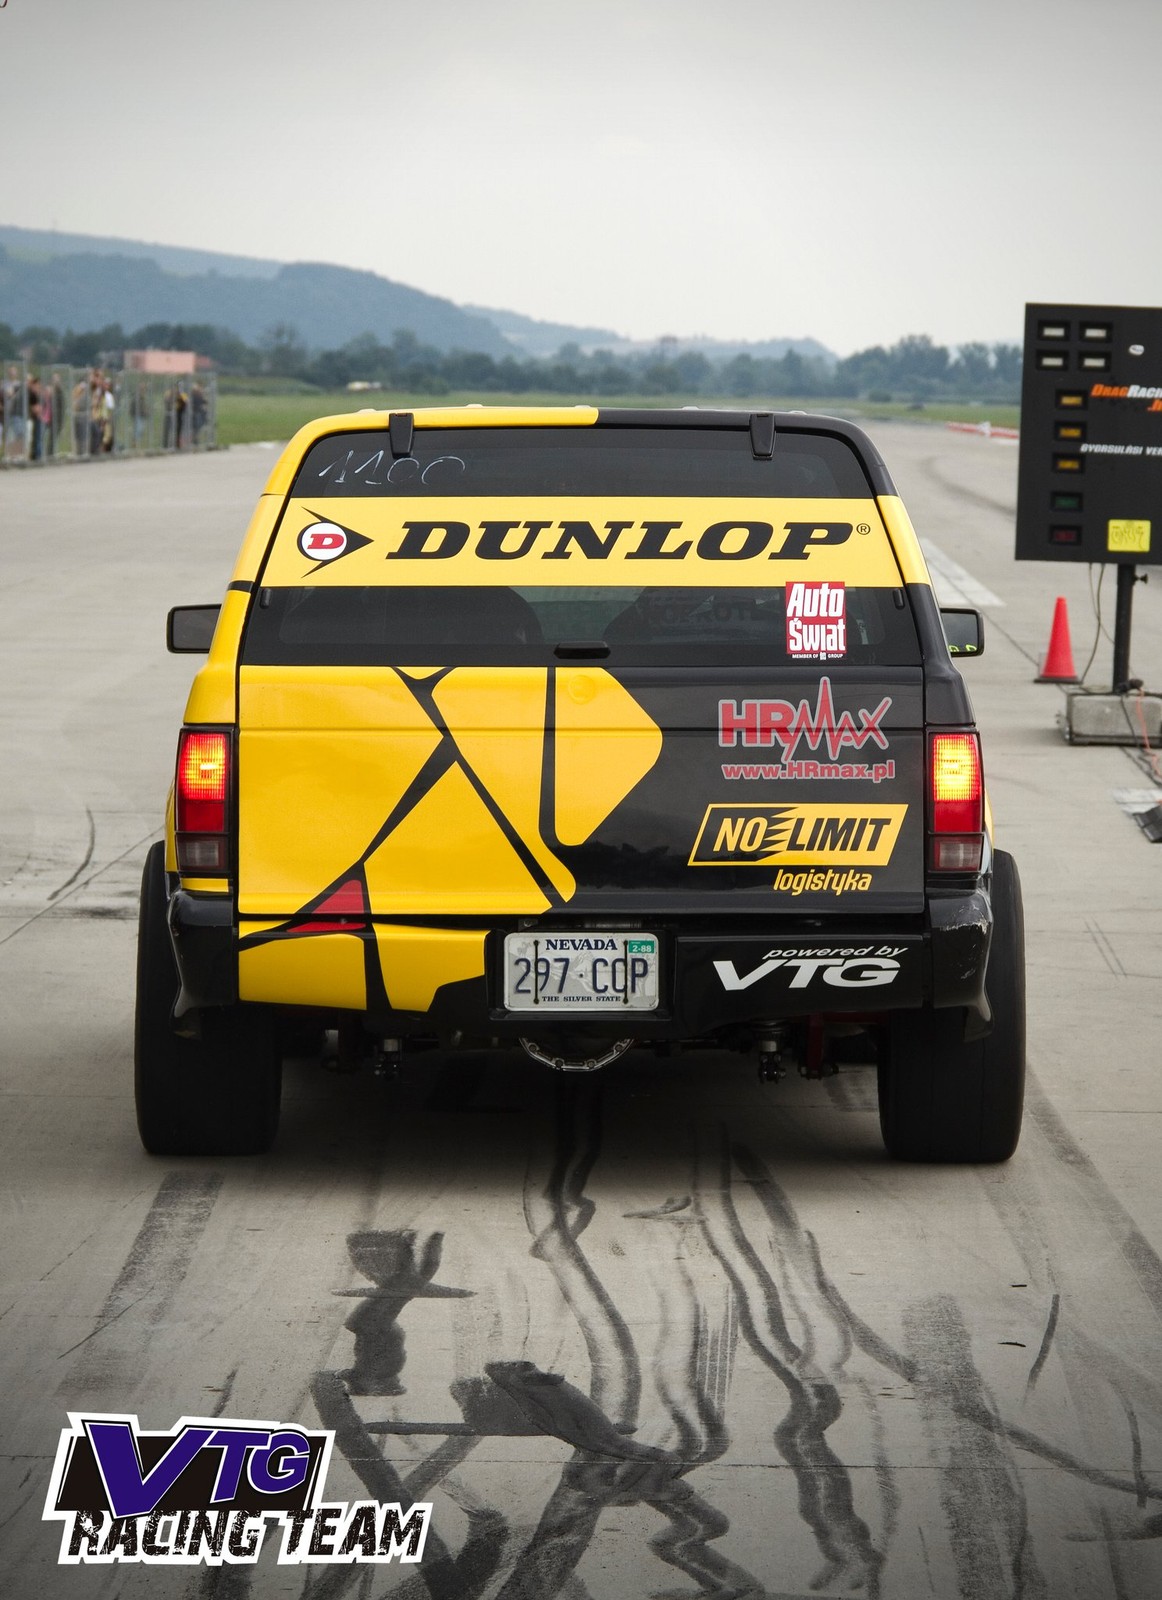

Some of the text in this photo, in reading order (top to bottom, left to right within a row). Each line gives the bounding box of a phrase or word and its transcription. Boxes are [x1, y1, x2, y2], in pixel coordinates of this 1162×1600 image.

[318, 449, 466, 485] 1100
[385, 520, 854, 560] DUNLOP
[786, 583, 845, 617] Auto
[789, 617, 846, 651] Świat
[721, 759, 895, 783] www.HRmax.pl
[712, 816, 893, 852] NO LIMIT
[773, 868, 873, 896] logistyka
[545, 938, 652, 953] NEVADA 2-88
[762, 945, 909, 960] powered by
[514, 957, 571, 994] 297
[712, 957, 902, 991] VTG
